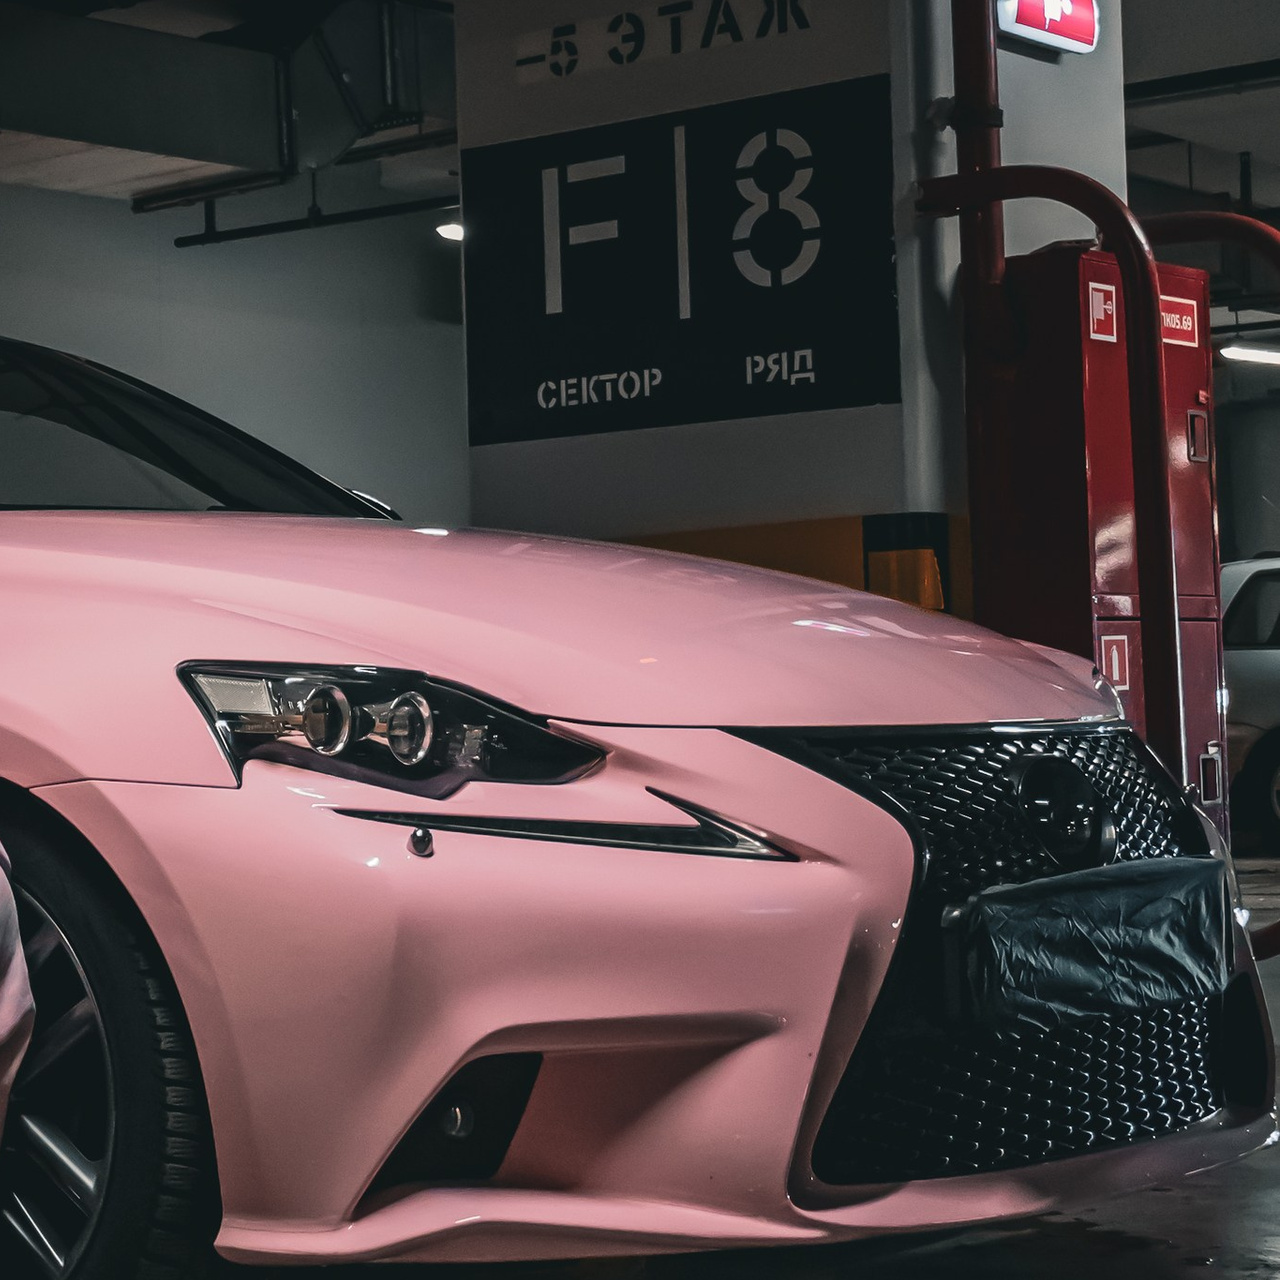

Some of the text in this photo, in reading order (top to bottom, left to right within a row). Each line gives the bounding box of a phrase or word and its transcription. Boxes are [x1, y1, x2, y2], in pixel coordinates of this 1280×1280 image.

[542, 128, 821, 315] F 8
[537, 349, 816, 409] СЕКТОР РЯД
